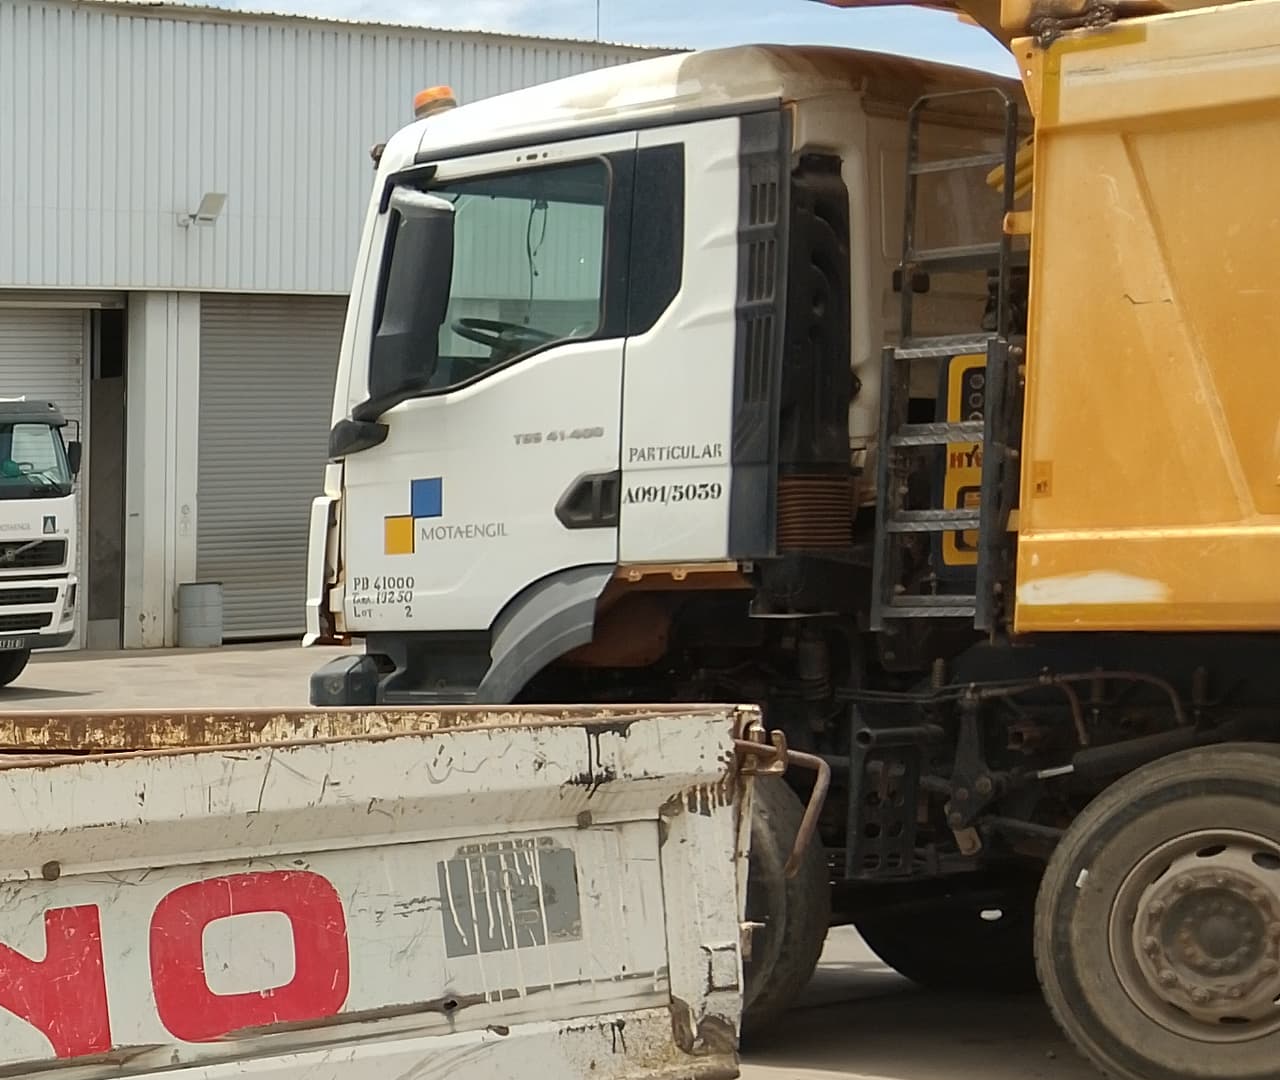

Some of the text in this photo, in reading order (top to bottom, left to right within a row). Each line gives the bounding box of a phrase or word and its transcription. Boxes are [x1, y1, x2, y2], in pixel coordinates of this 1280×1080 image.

[629, 443, 723, 463] PARTICULAR
[622, 483, 723, 506] A091/5039
[374, 576, 415, 590] 41000
[405, 605, 413, 618] 2
